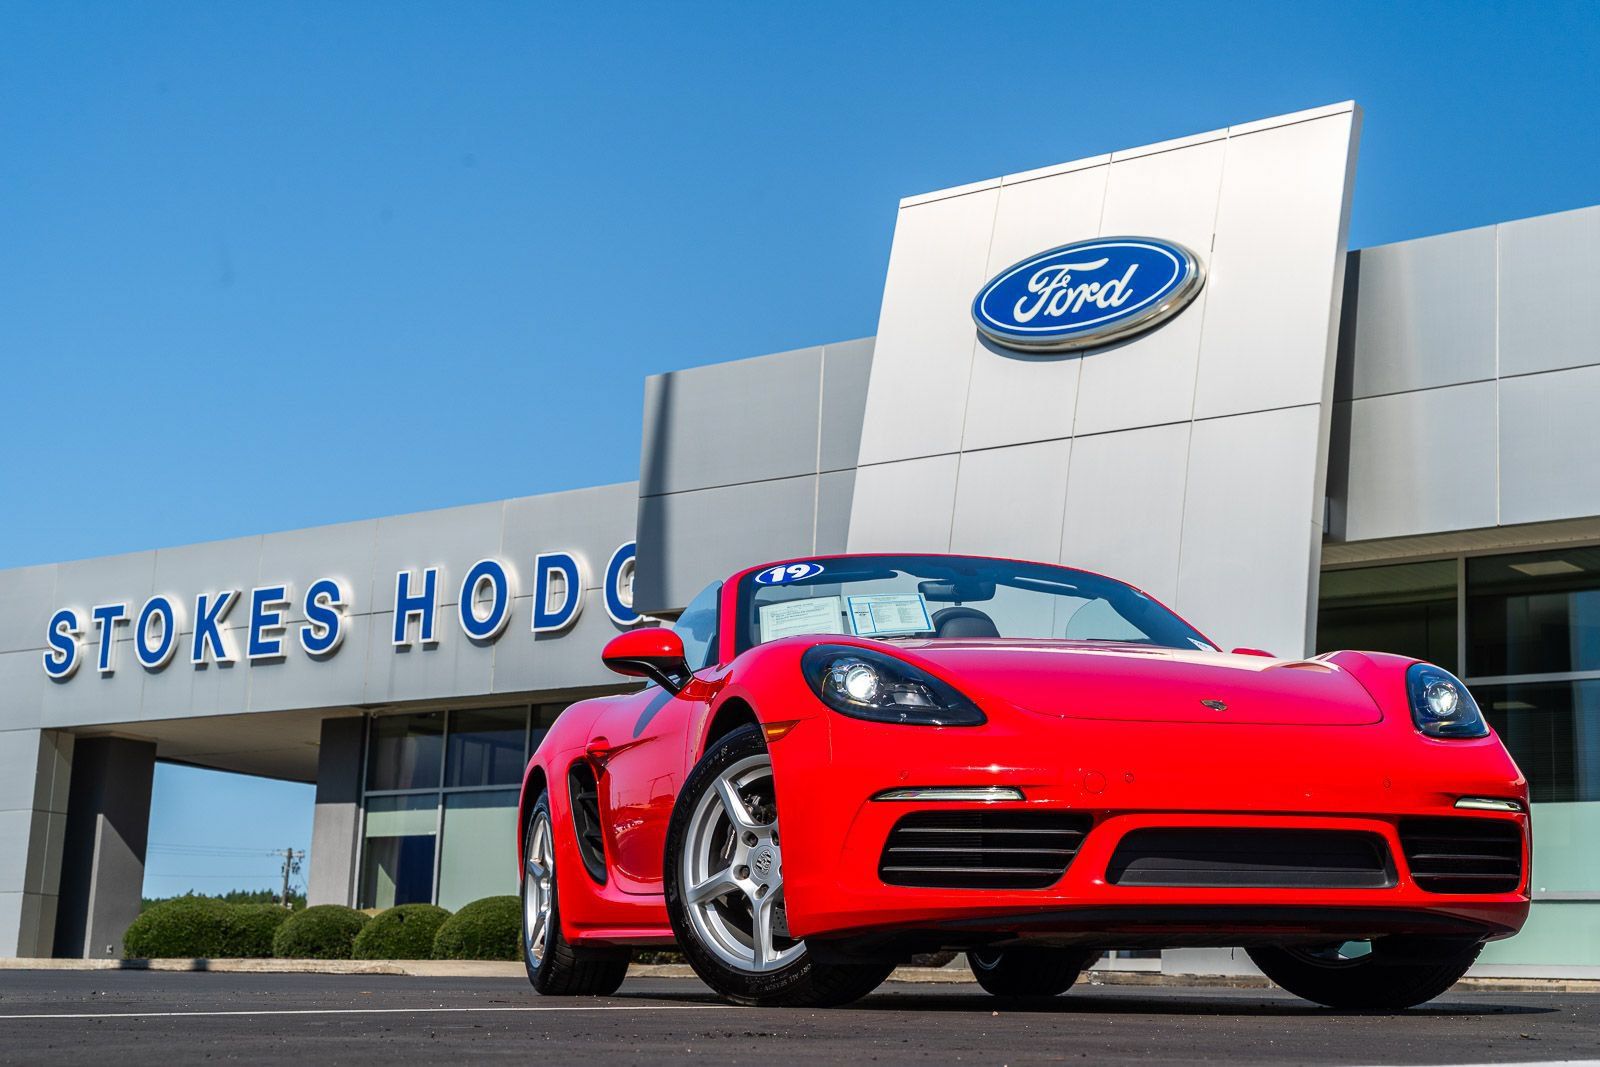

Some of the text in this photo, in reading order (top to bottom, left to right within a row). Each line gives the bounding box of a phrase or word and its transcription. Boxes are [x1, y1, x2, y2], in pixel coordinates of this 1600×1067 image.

[1013, 257, 1139, 323] Ford
[769, 564, 811, 583] 19
[43, 578, 344, 678] STOKES
